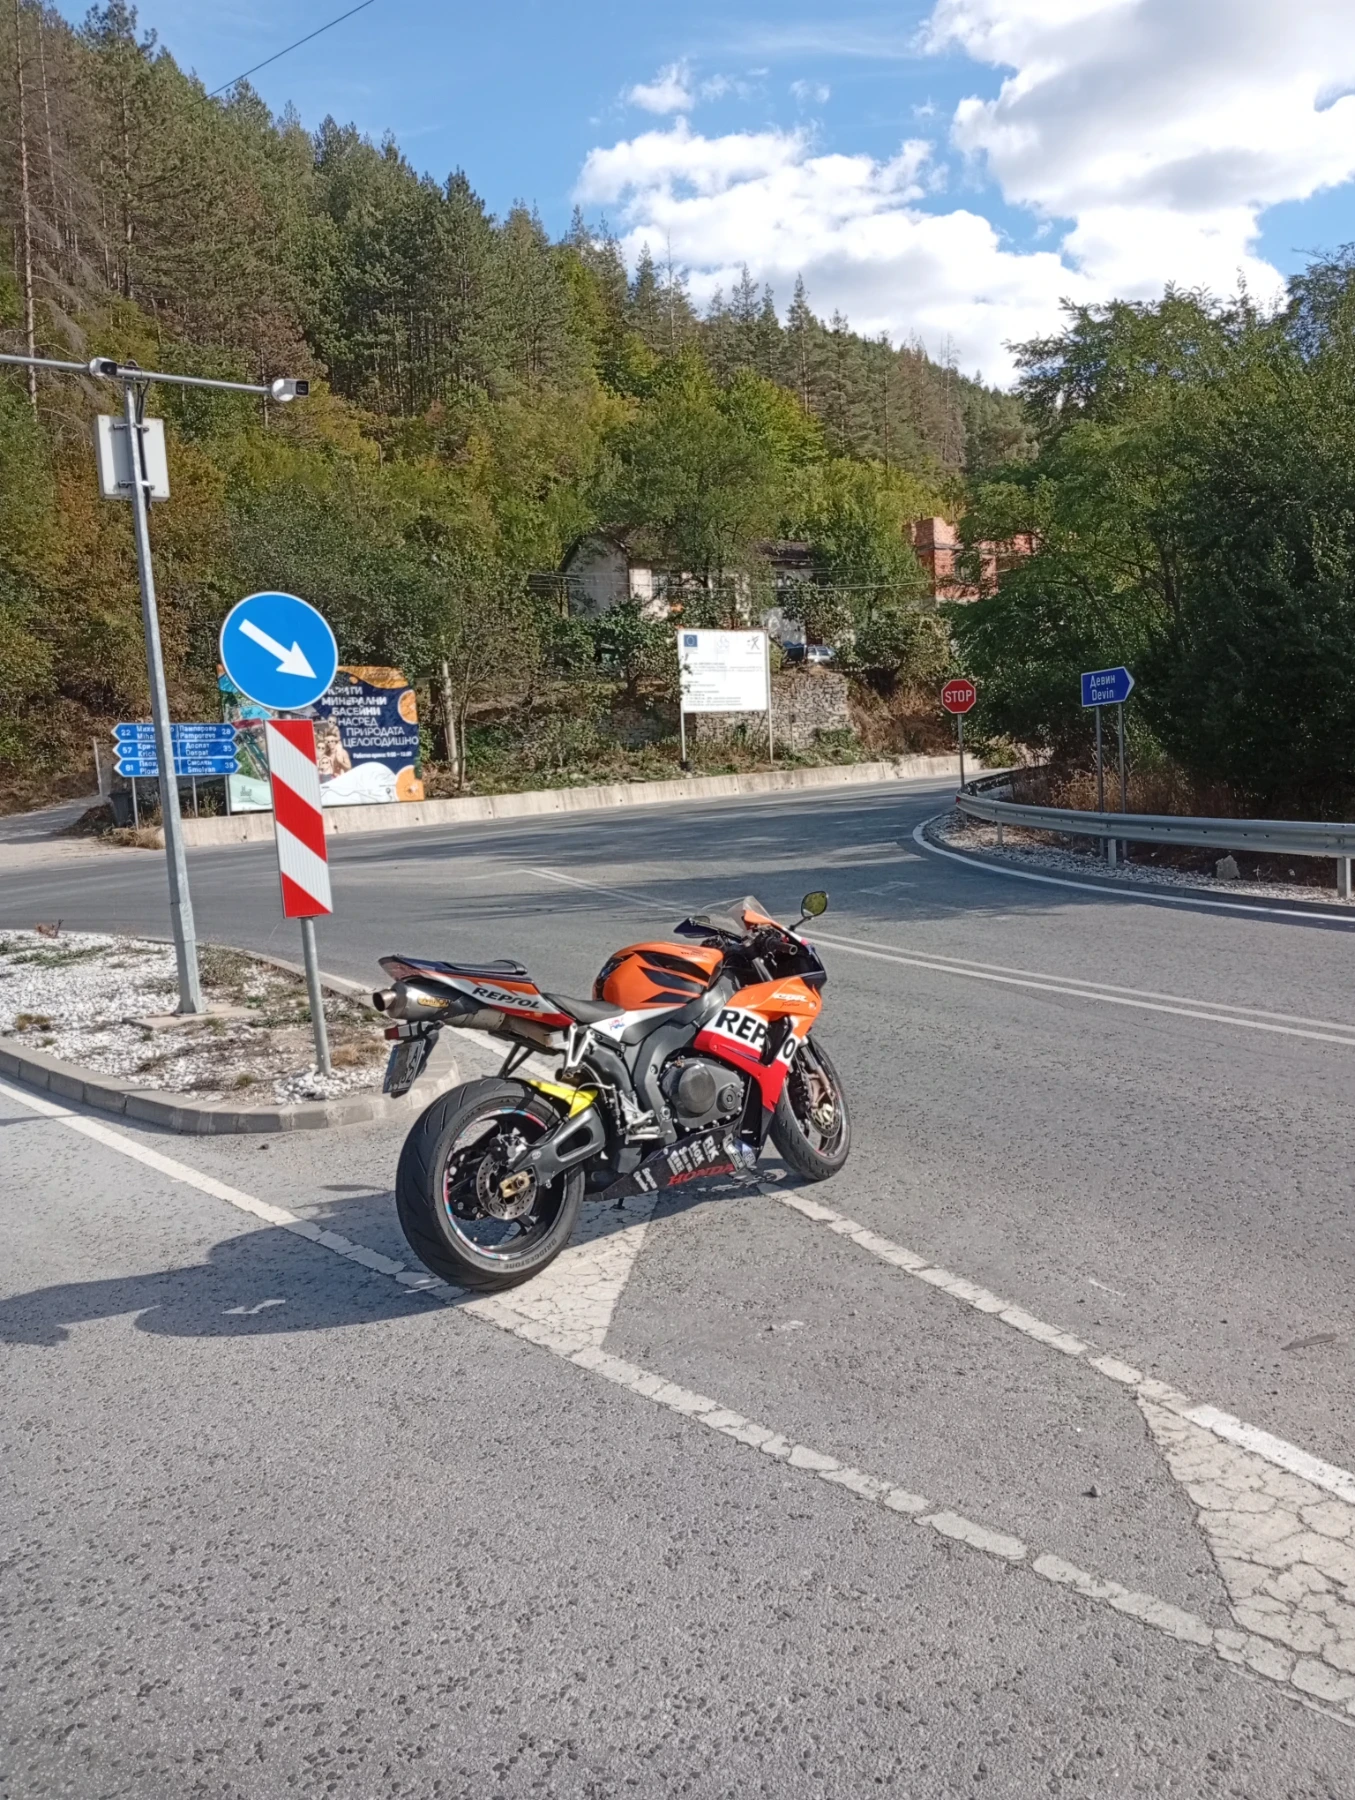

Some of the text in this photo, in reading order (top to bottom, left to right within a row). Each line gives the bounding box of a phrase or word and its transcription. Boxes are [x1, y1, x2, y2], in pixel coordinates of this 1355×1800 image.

[1090, 675, 1116, 688] Девин
[945, 690, 973, 703] STOP
[1091, 687, 1114, 701] Devin
[332, 705, 381, 716] БАСЕЙНИ
[338, 717, 378, 727] НАСРЕД
[346, 727, 405, 737] ПРИРОДАТА
[343, 736, 419, 748] ЦЕЛОГОДИШНО
[472, 987, 540, 1009] REPSOL
[714, 1009, 796, 1060] REPO
[667, 1163, 735, 1187] HONDA
[503, 1237, 558, 1269] BRIDGESTONE
